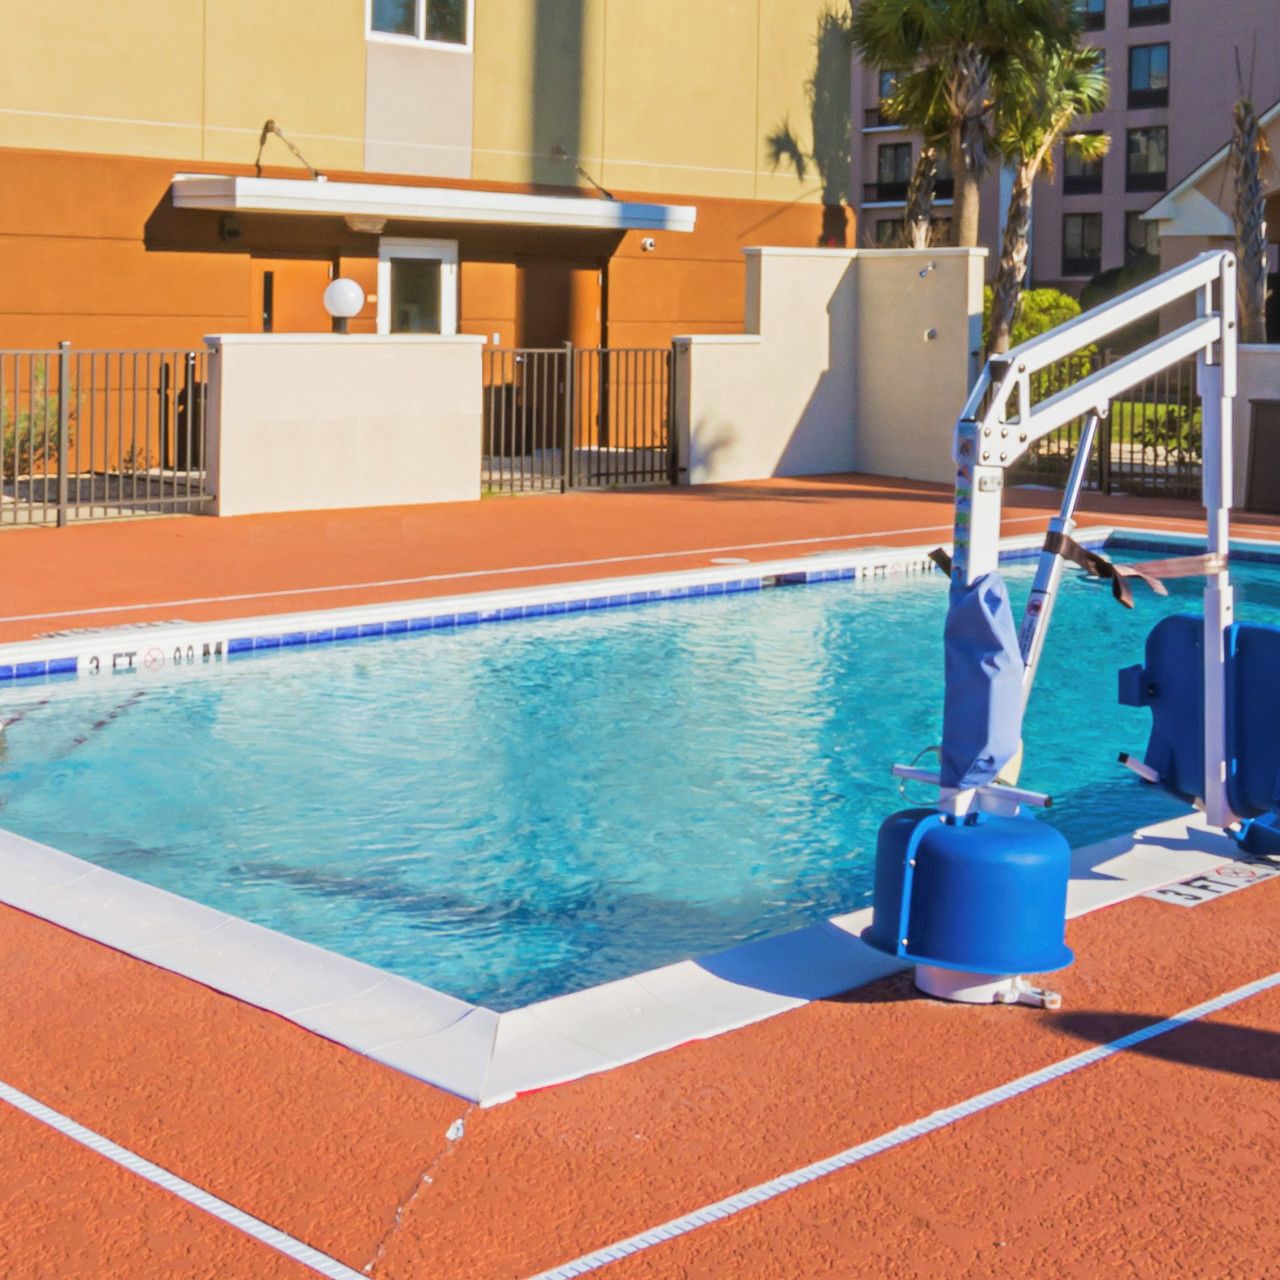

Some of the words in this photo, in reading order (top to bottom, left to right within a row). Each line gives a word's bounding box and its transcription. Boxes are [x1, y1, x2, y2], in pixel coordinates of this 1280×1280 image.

[112, 651, 138, 669] FT
[1179, 876, 1238, 893] FT
[1156, 889, 1203, 901] 3
